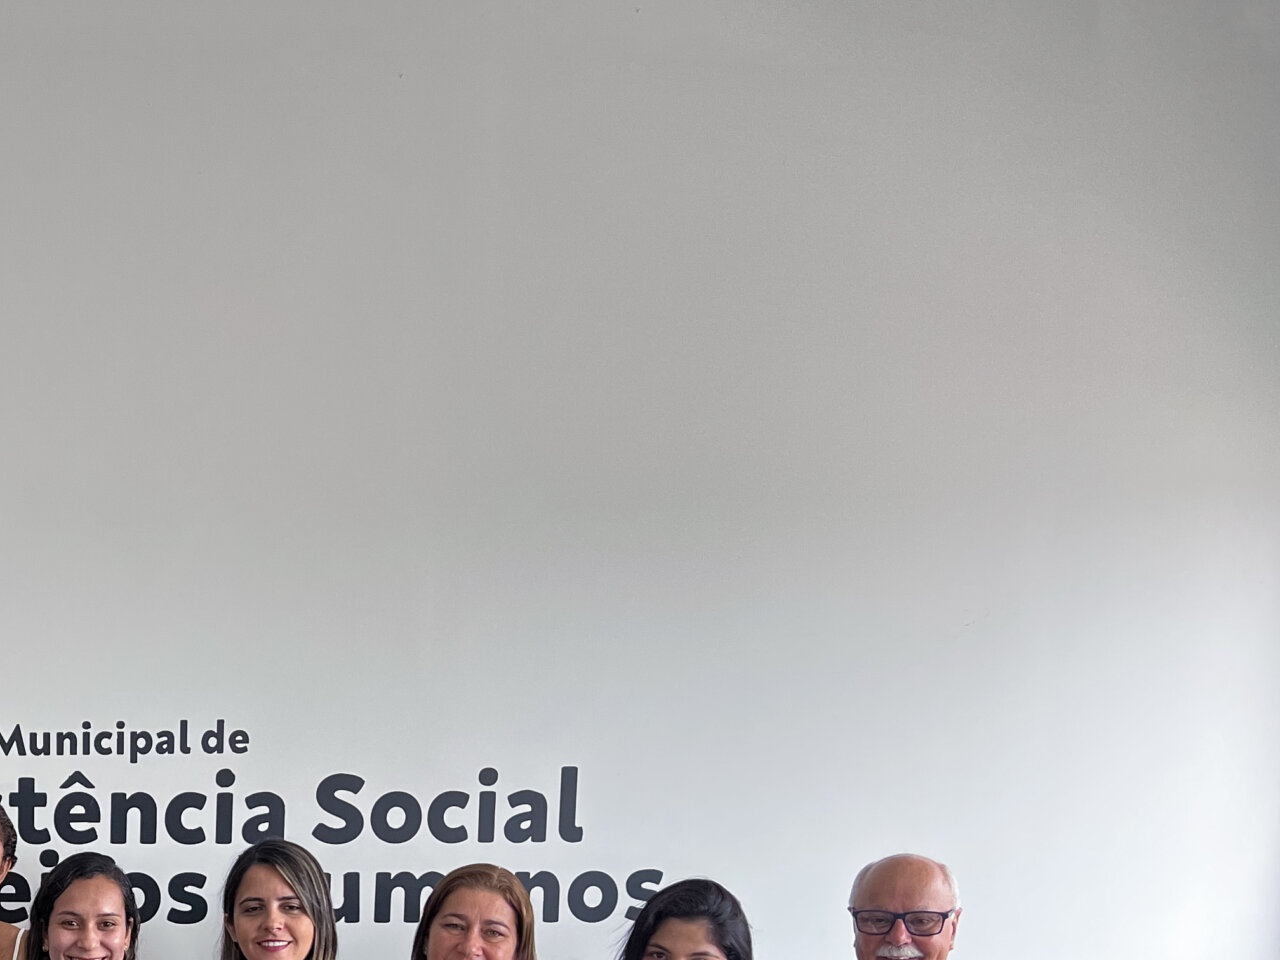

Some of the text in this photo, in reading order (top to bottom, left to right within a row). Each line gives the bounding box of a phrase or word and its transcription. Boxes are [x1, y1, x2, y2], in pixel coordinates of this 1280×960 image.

[201, 719, 250, 754] de
[312, 766, 583, 844] Social
[328, 868, 665, 924] umnos
